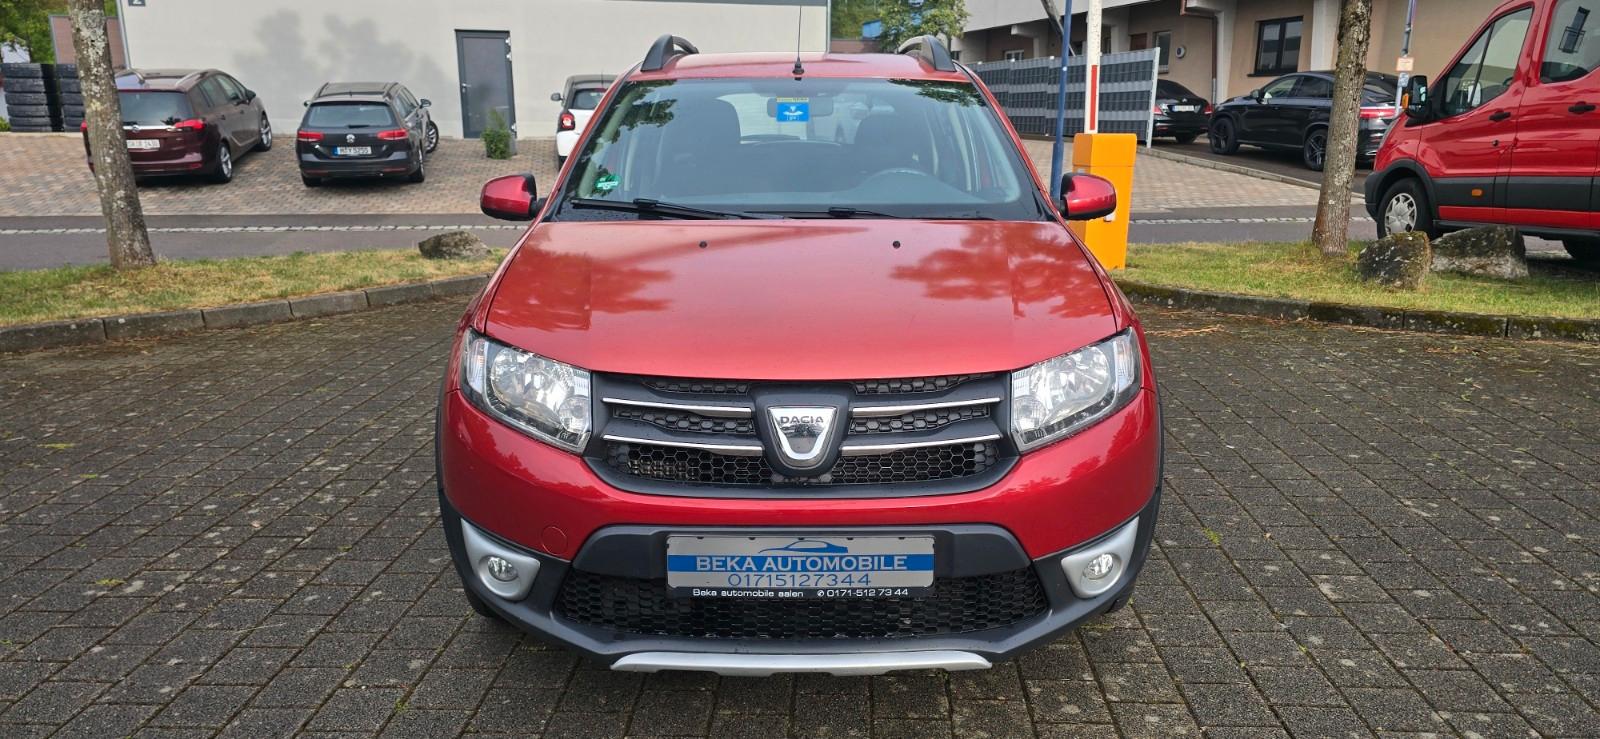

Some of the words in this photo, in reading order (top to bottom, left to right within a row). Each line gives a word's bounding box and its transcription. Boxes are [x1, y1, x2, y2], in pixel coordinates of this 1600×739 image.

[780, 416, 824, 424] DACIA
[696, 556, 757, 571] BEKA
[762, 556, 908, 571] AUTOMOBILE
[728, 573, 871, 587] 01715127344
[692, 588, 717, 597] Beka
[721, 589, 775, 597] automobile
[778, 590, 804, 598] aalen
[826, 588, 876, 597] 0171-512
[878, 588, 892, 596] 73
[894, 588, 909, 596] 44
